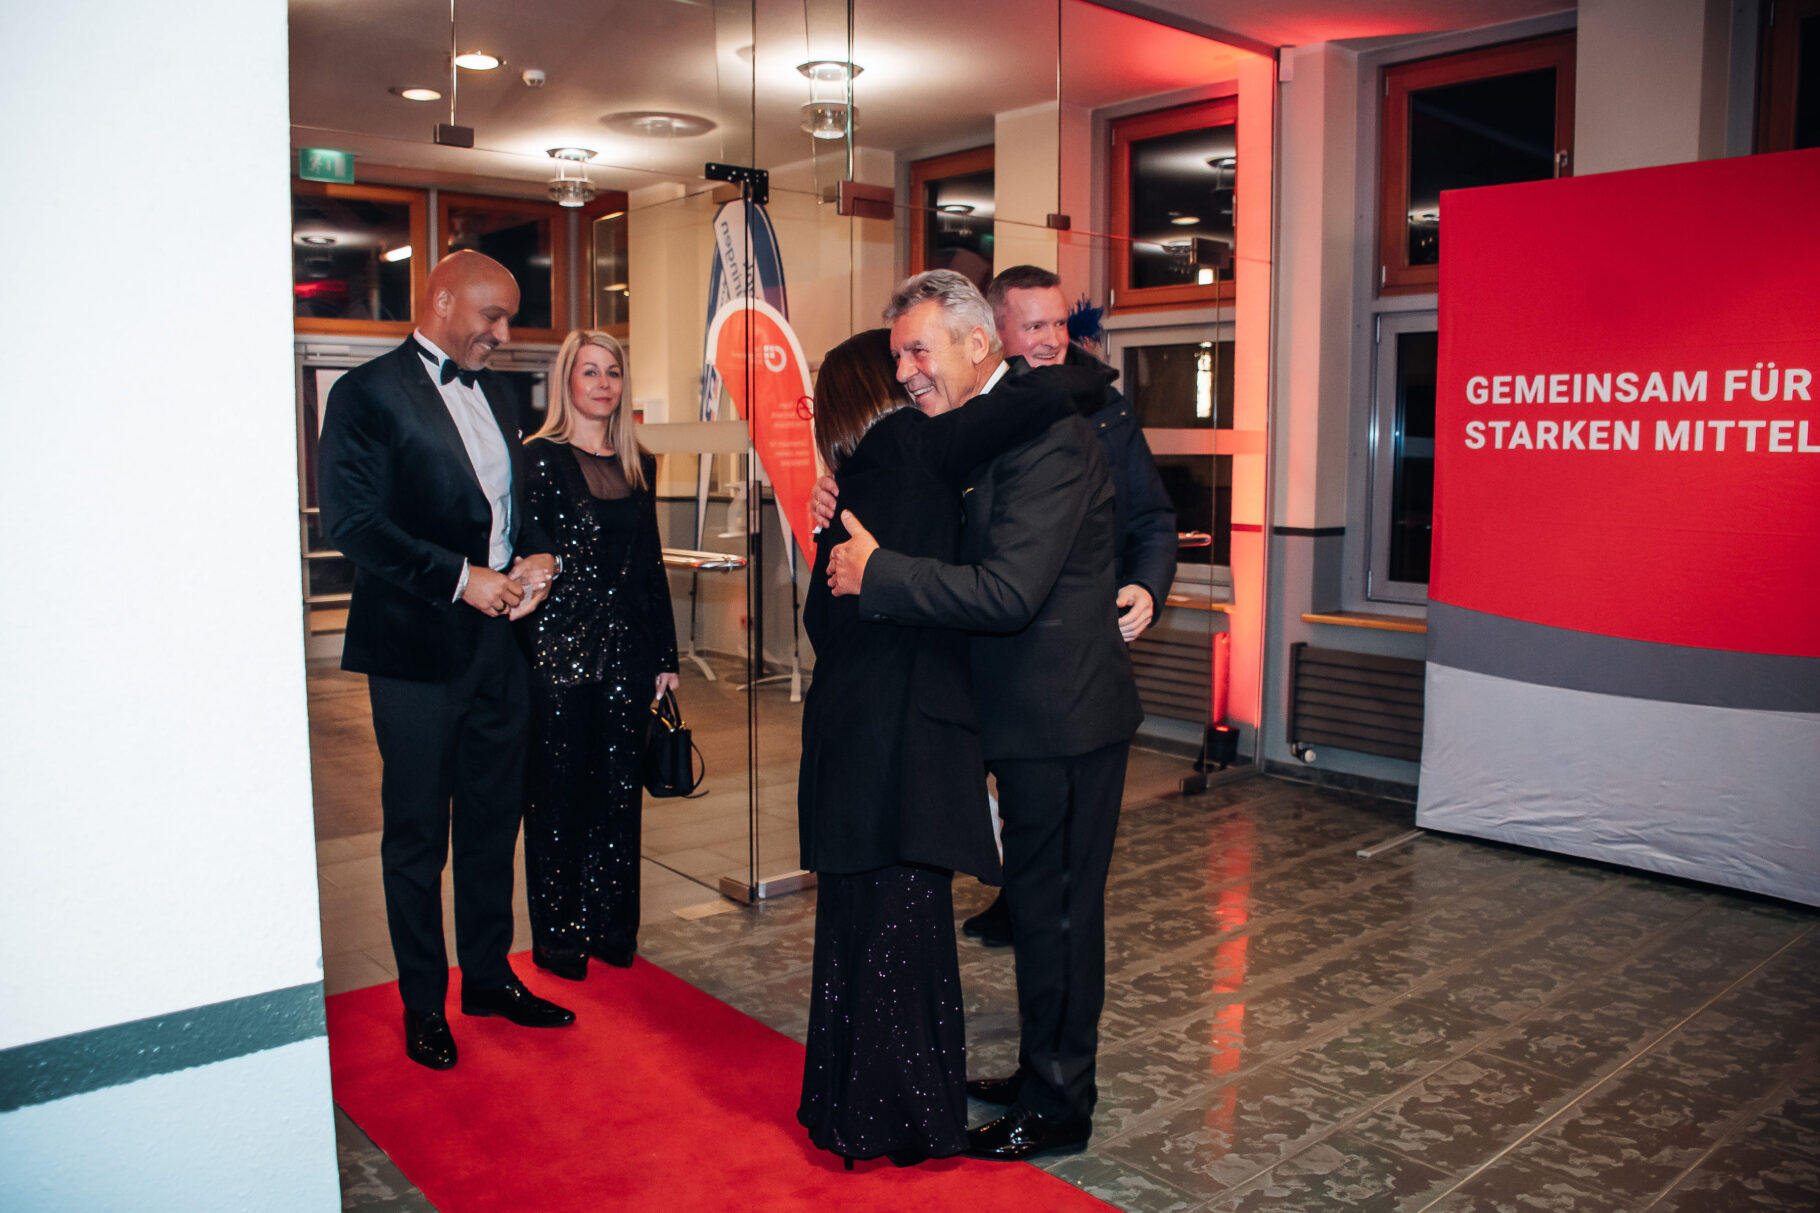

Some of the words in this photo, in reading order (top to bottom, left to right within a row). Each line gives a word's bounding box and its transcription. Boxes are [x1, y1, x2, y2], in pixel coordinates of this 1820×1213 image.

[1465, 371, 1708, 405] GEMEINSAM
[1723, 361, 1813, 402] FÜR
[1464, 420, 1640, 451] STARKEN
[1654, 420, 1820, 453] MITTEL
